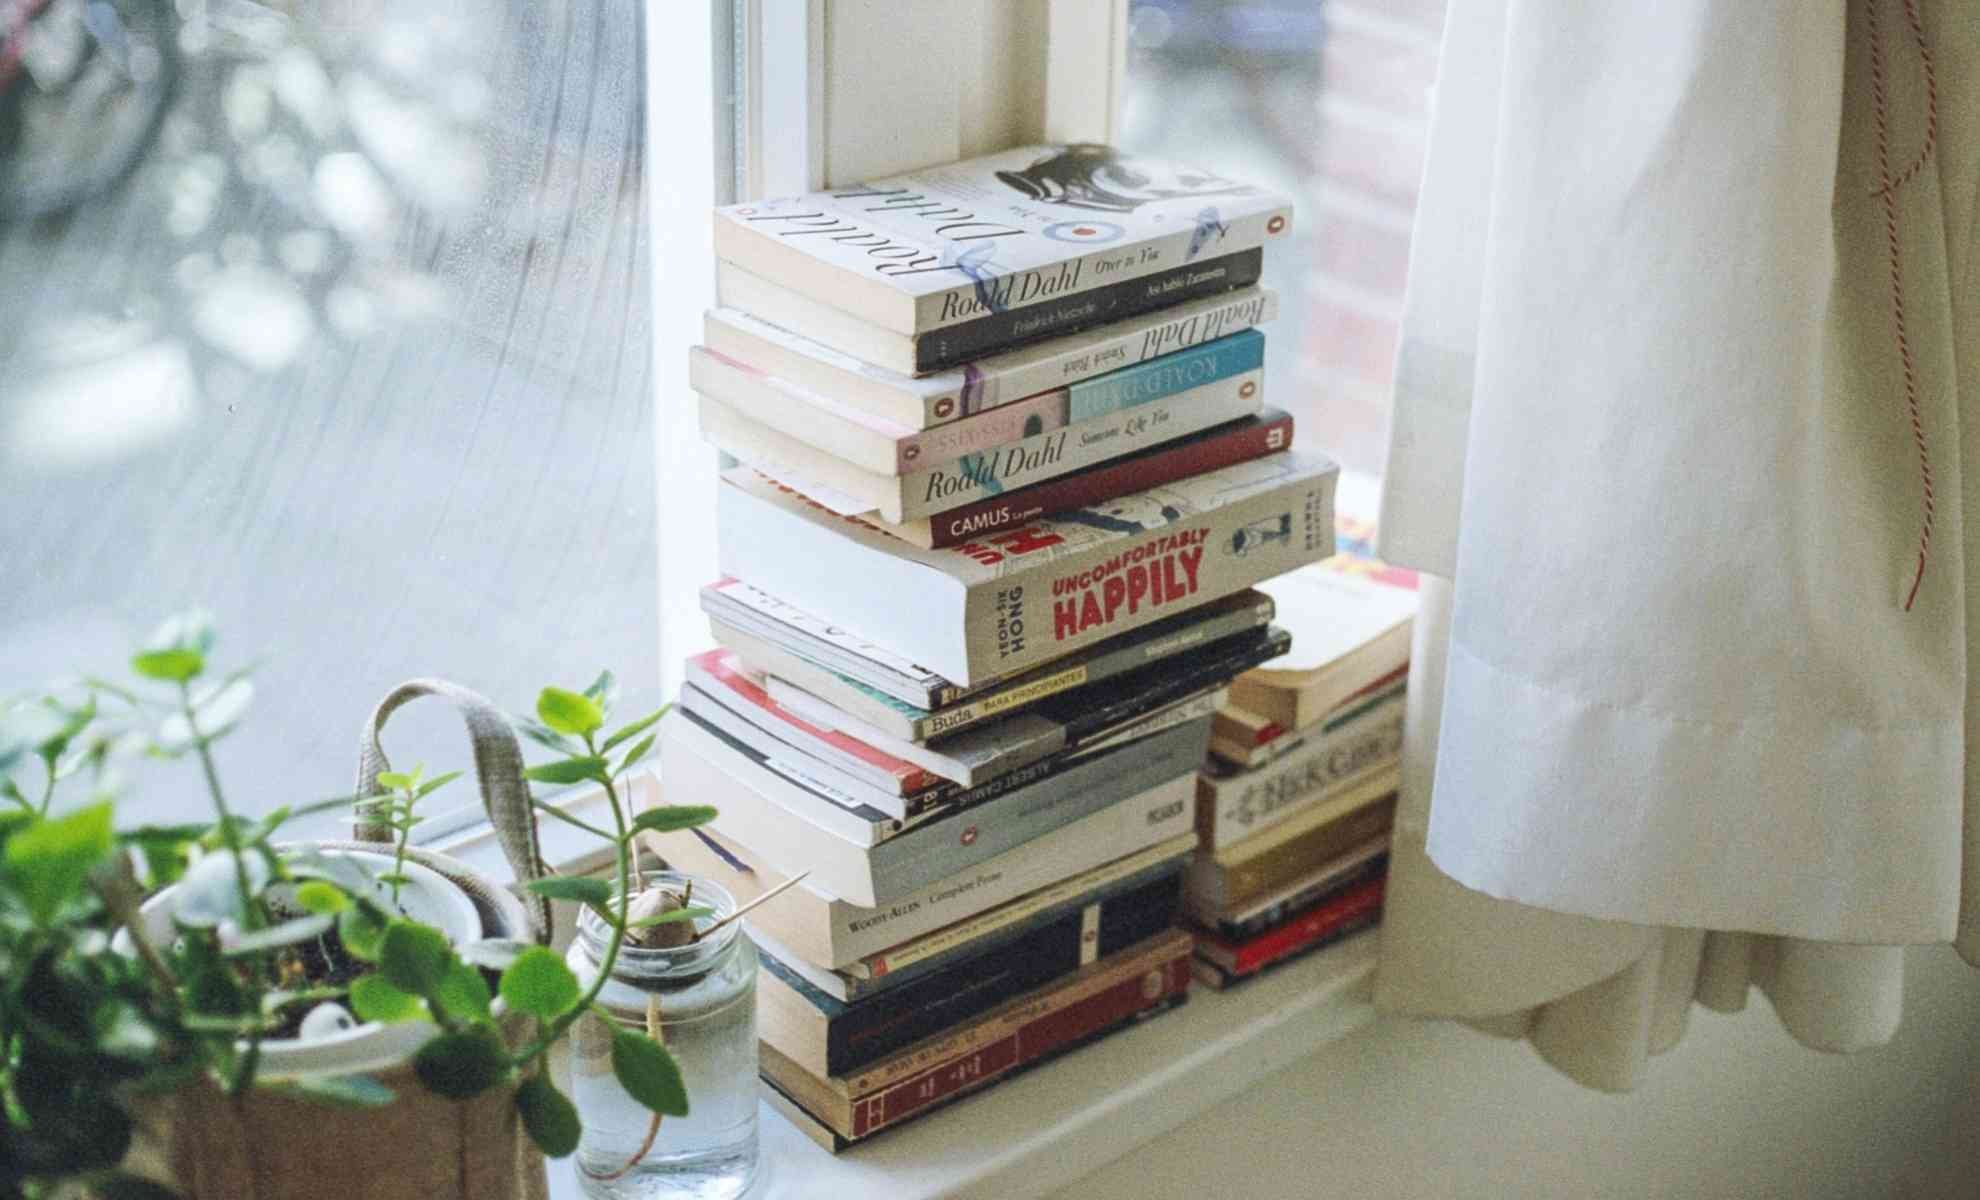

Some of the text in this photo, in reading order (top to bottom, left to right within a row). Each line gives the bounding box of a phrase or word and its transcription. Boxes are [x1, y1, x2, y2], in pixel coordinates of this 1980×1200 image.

[940, 268, 1015, 321] Roald
[1020, 258, 1083, 302] Dahl
[1202, 297, 1266, 342] Roald
[1140, 314, 1202, 361] Dahl
[926, 455, 998, 502] Roald
[1005, 432, 1067, 478] Dahl
[951, 506, 1010, 537] CAMUS
[1053, 528, 1210, 597] UNCOMFORTABLY
[1053, 547, 1204, 640] HAPPILY
[998, 591, 1009, 658] YEON-SIK
[1010, 585, 1024, 652] HONG
[932, 707, 973, 732] Buda
